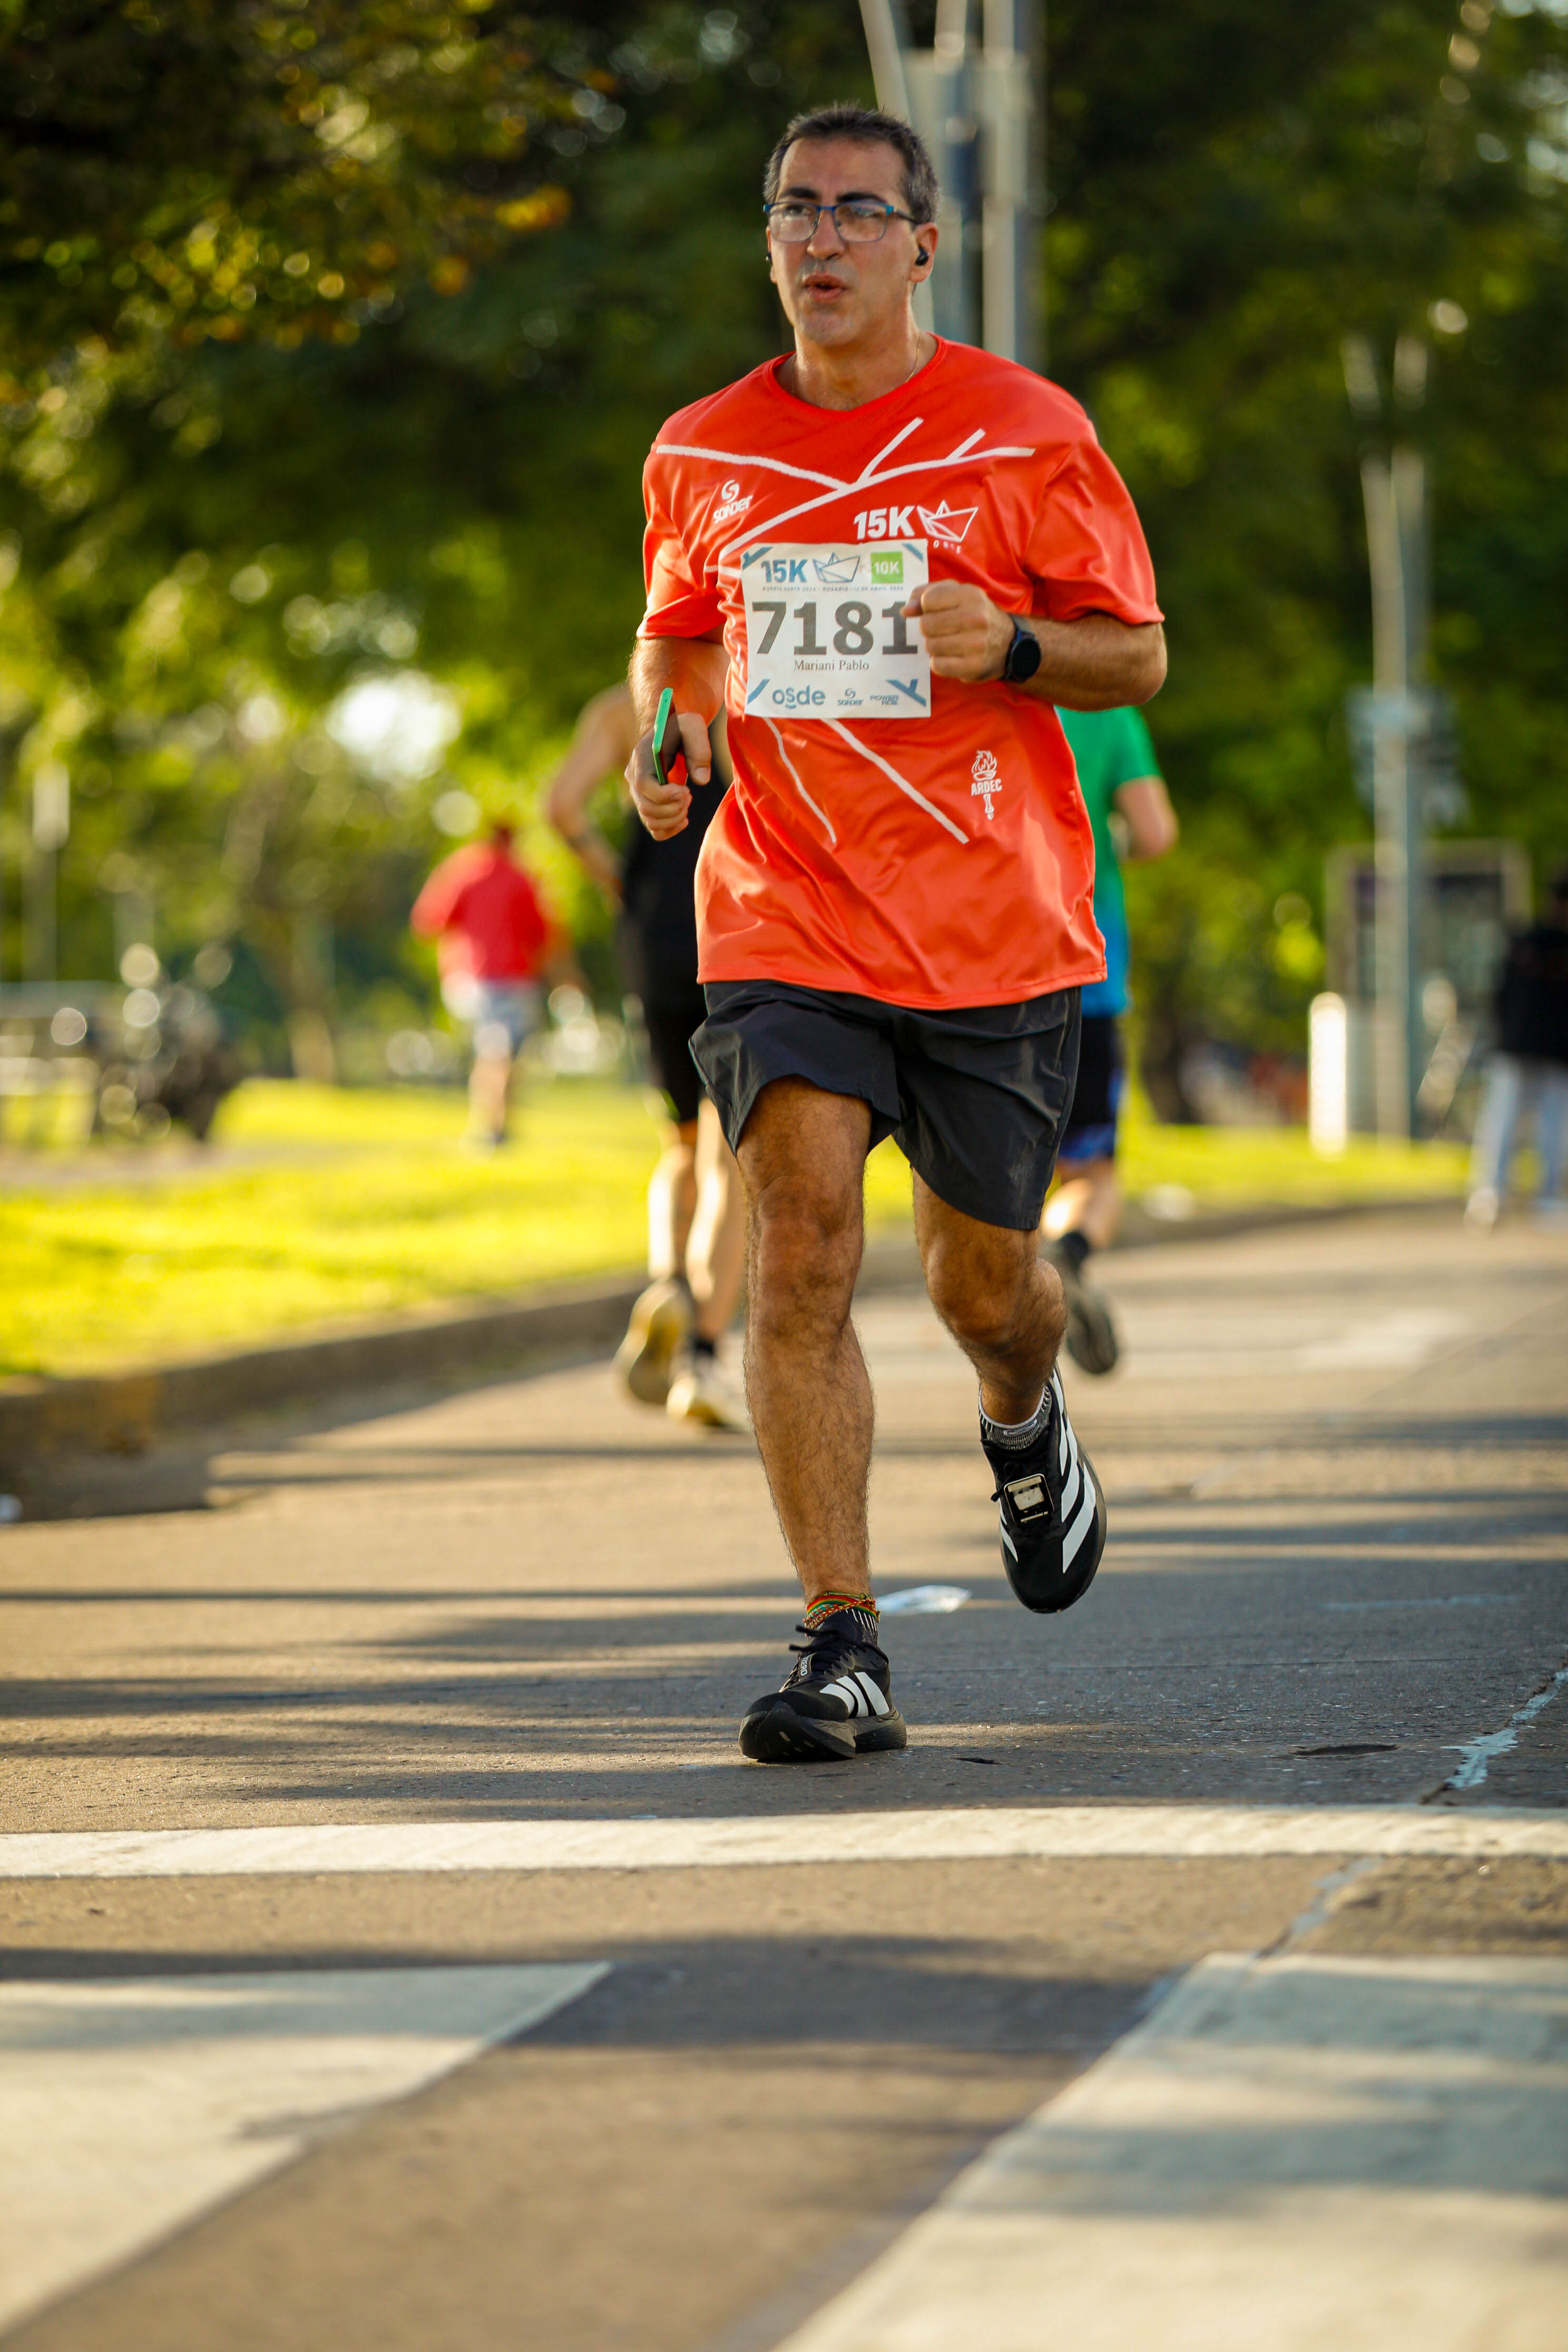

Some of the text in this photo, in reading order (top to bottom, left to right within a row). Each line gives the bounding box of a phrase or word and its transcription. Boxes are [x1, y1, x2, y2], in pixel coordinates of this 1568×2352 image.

[854, 505, 915, 540] 15K
[760, 559, 809, 583] 15K
[873, 561, 900, 575] 10K
[752, 601, 918, 655] 7181
[793, 659, 869, 671] Mariani Pablo
[772, 685, 826, 705] osde
[971, 778, 1003, 796] ARDEC
